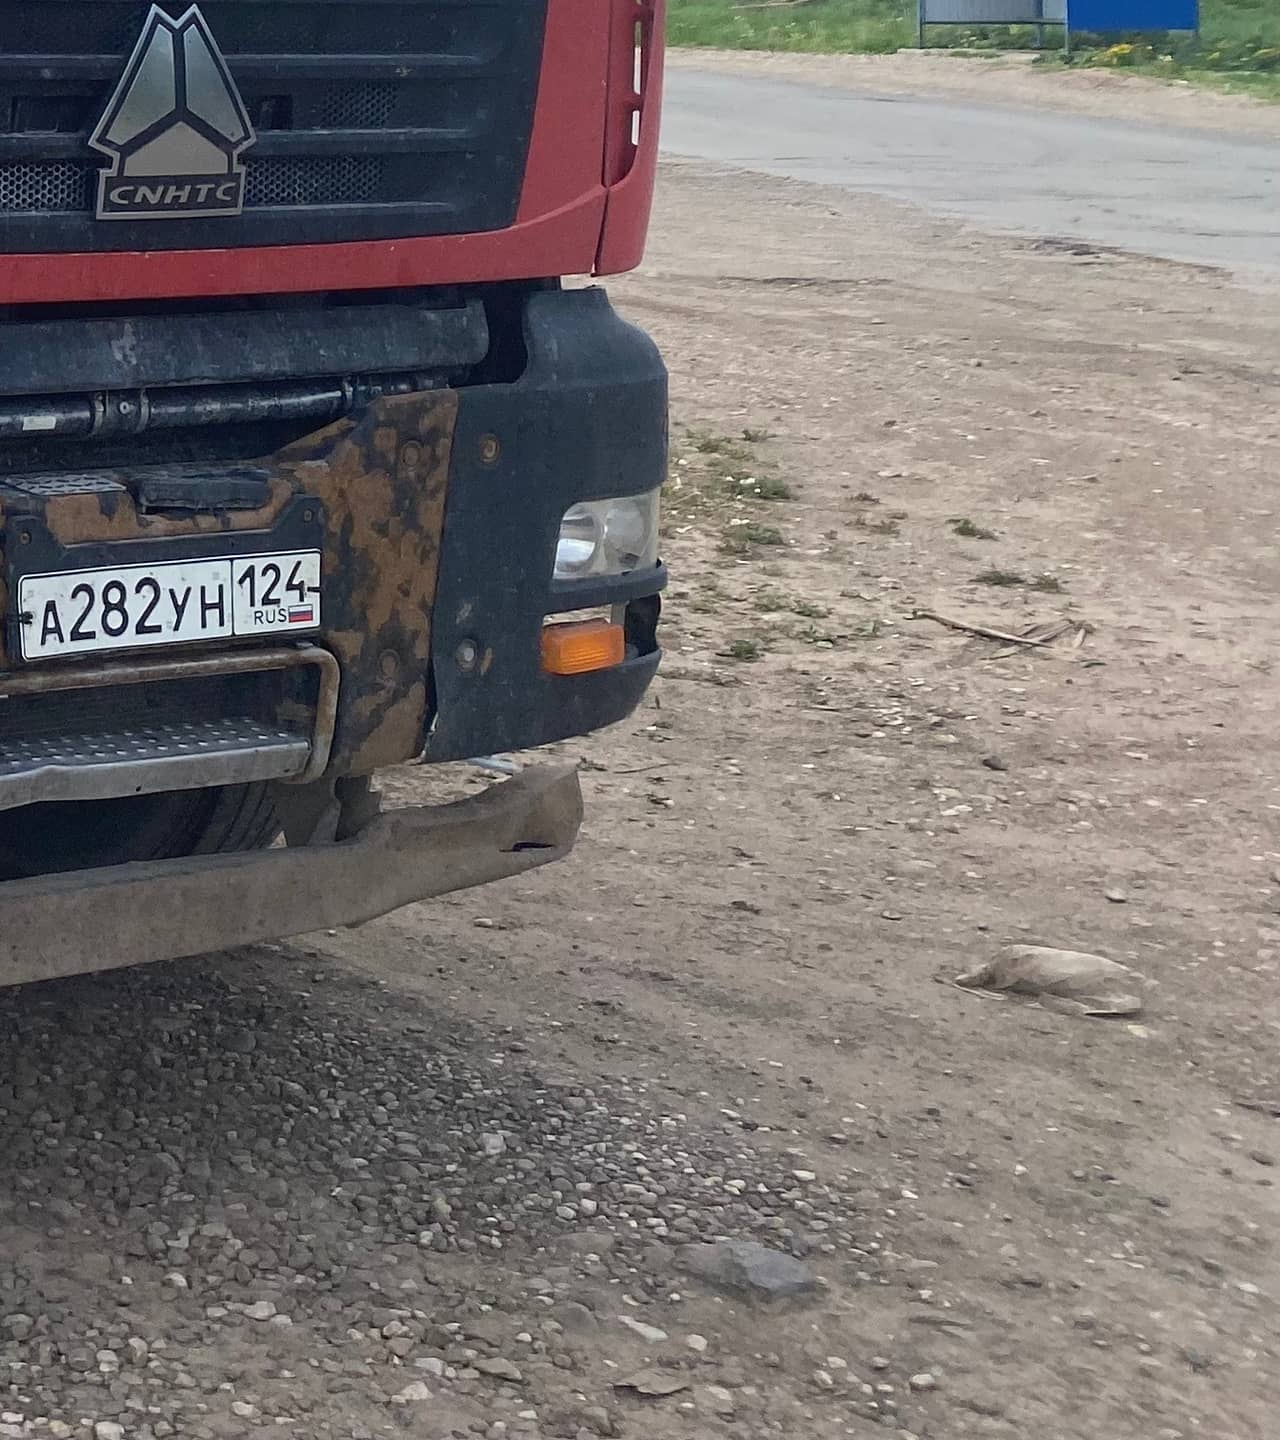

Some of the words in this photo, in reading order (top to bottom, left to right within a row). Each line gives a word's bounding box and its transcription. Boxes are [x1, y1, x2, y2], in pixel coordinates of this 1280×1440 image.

[109, 181, 237, 205] CNHTC
[238, 560, 306, 608] 124
[254, 608, 288, 626] RUS
